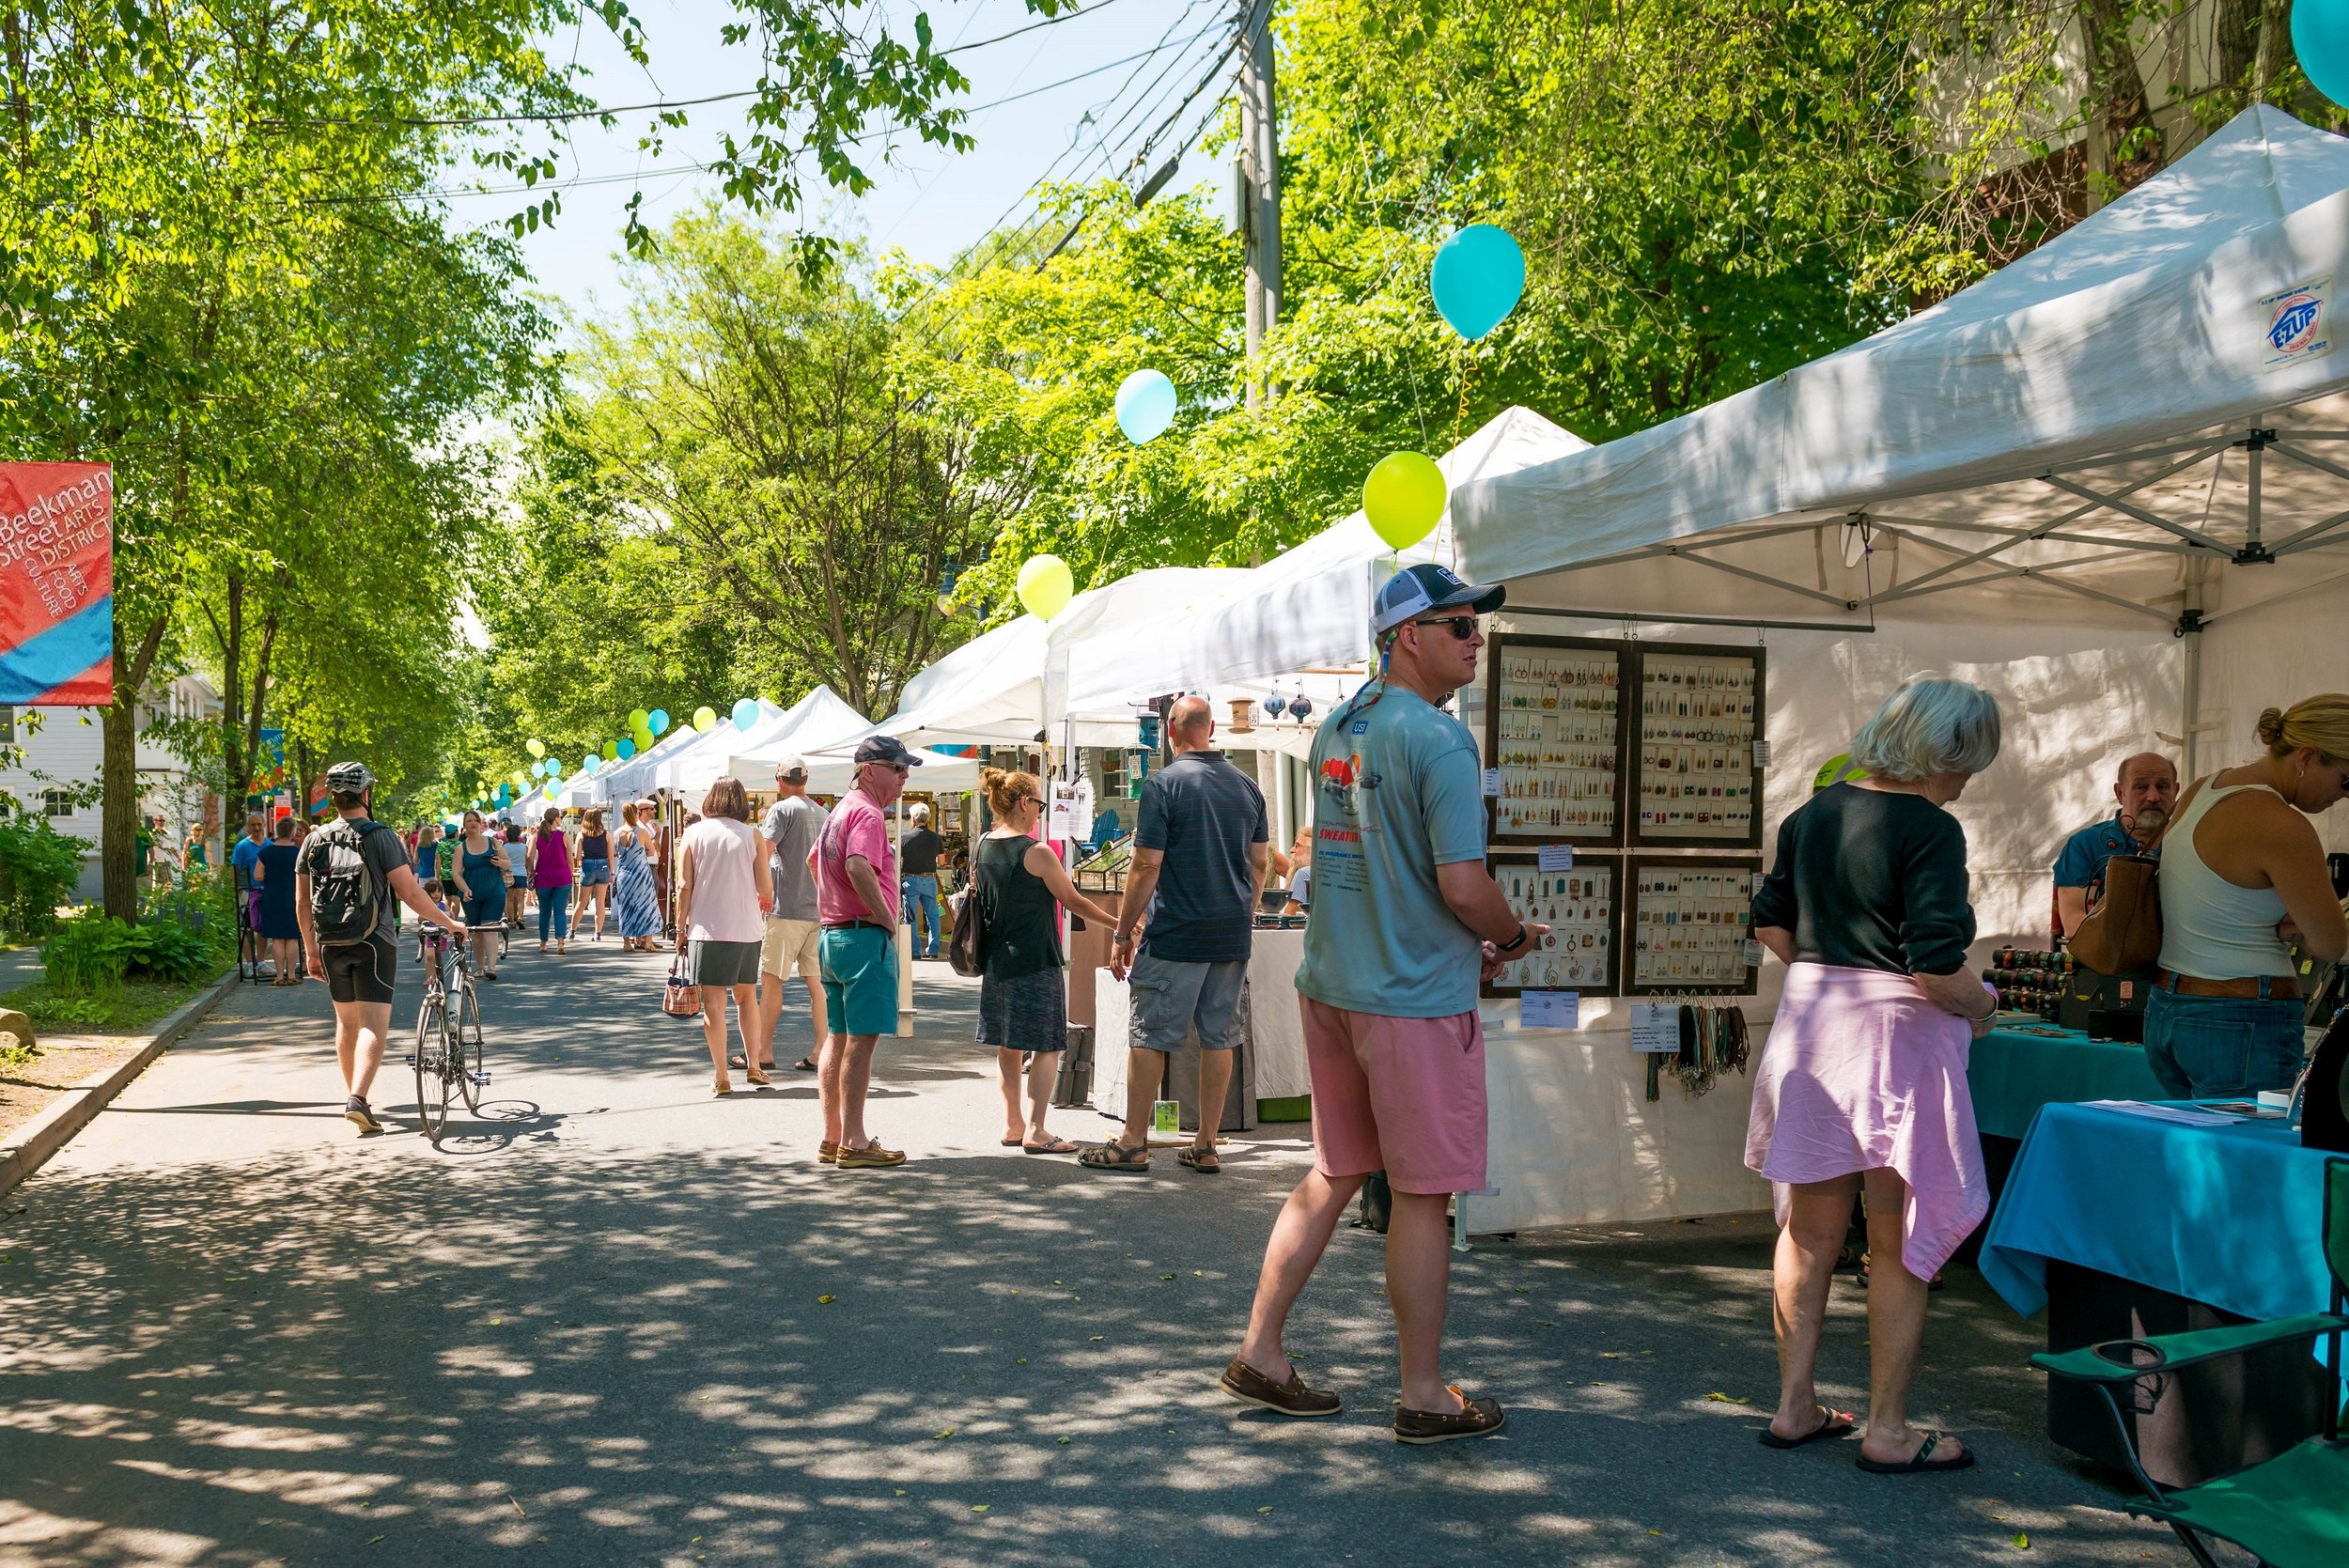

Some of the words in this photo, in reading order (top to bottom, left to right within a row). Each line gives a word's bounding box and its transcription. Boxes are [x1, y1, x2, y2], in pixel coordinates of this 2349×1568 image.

[0, 471, 112, 545] Beekman
[0, 519, 63, 567] Street
[64, 499, 104, 534] ARTS
[40, 517, 112, 567] DISTRICT
[24, 557, 63, 619] CULTURE
[50, 569, 77, 610] FOOD
[67, 564, 89, 597] ARTS
